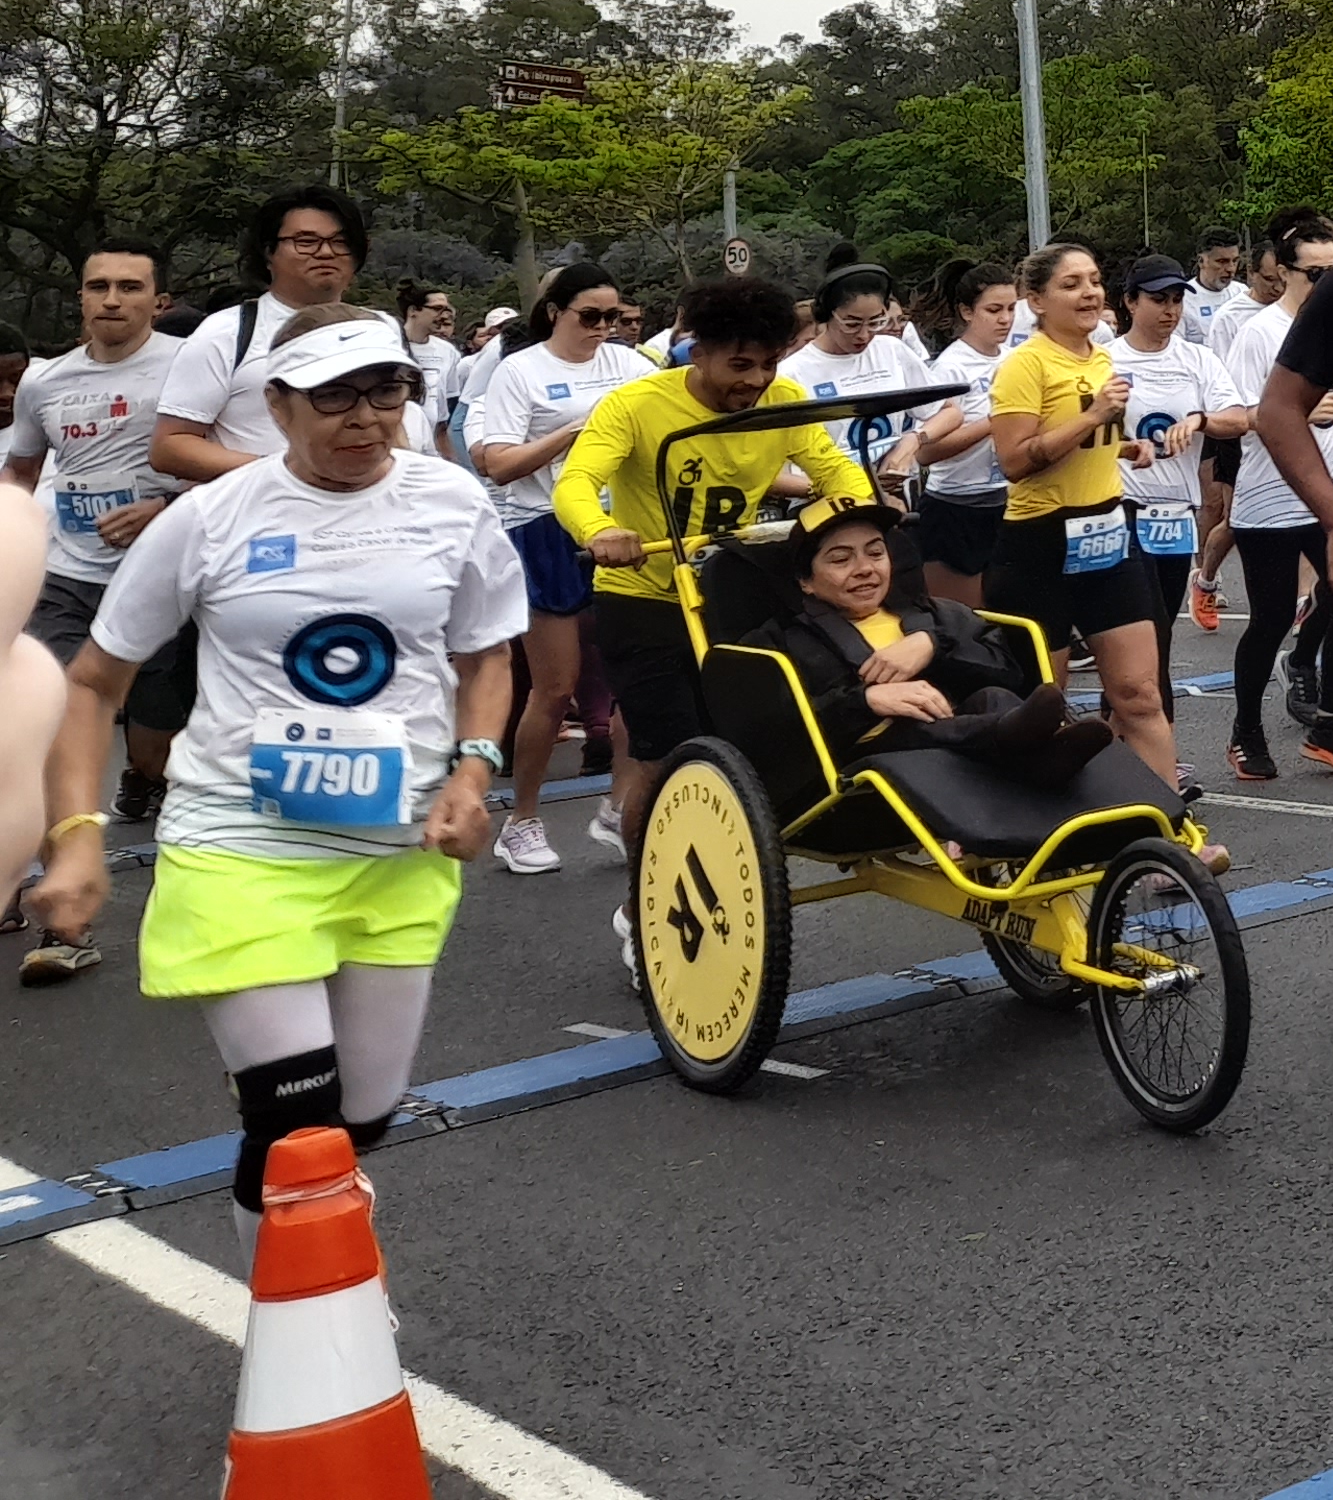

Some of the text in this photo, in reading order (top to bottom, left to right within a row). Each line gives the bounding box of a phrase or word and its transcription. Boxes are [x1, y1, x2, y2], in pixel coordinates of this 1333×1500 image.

[728, 246, 748, 264] 50
[60, 422, 98, 441] 70.3
[826, 497, 856, 515] IR
[1148, 521, 1184, 542] 7734
[280, 750, 380, 797] 7790
[655, 783, 729, 836] INCLUSÃO
[1004, 911, 1038, 942] RUN
[675, 842, 756, 1043] TODOS MERECEM IR
